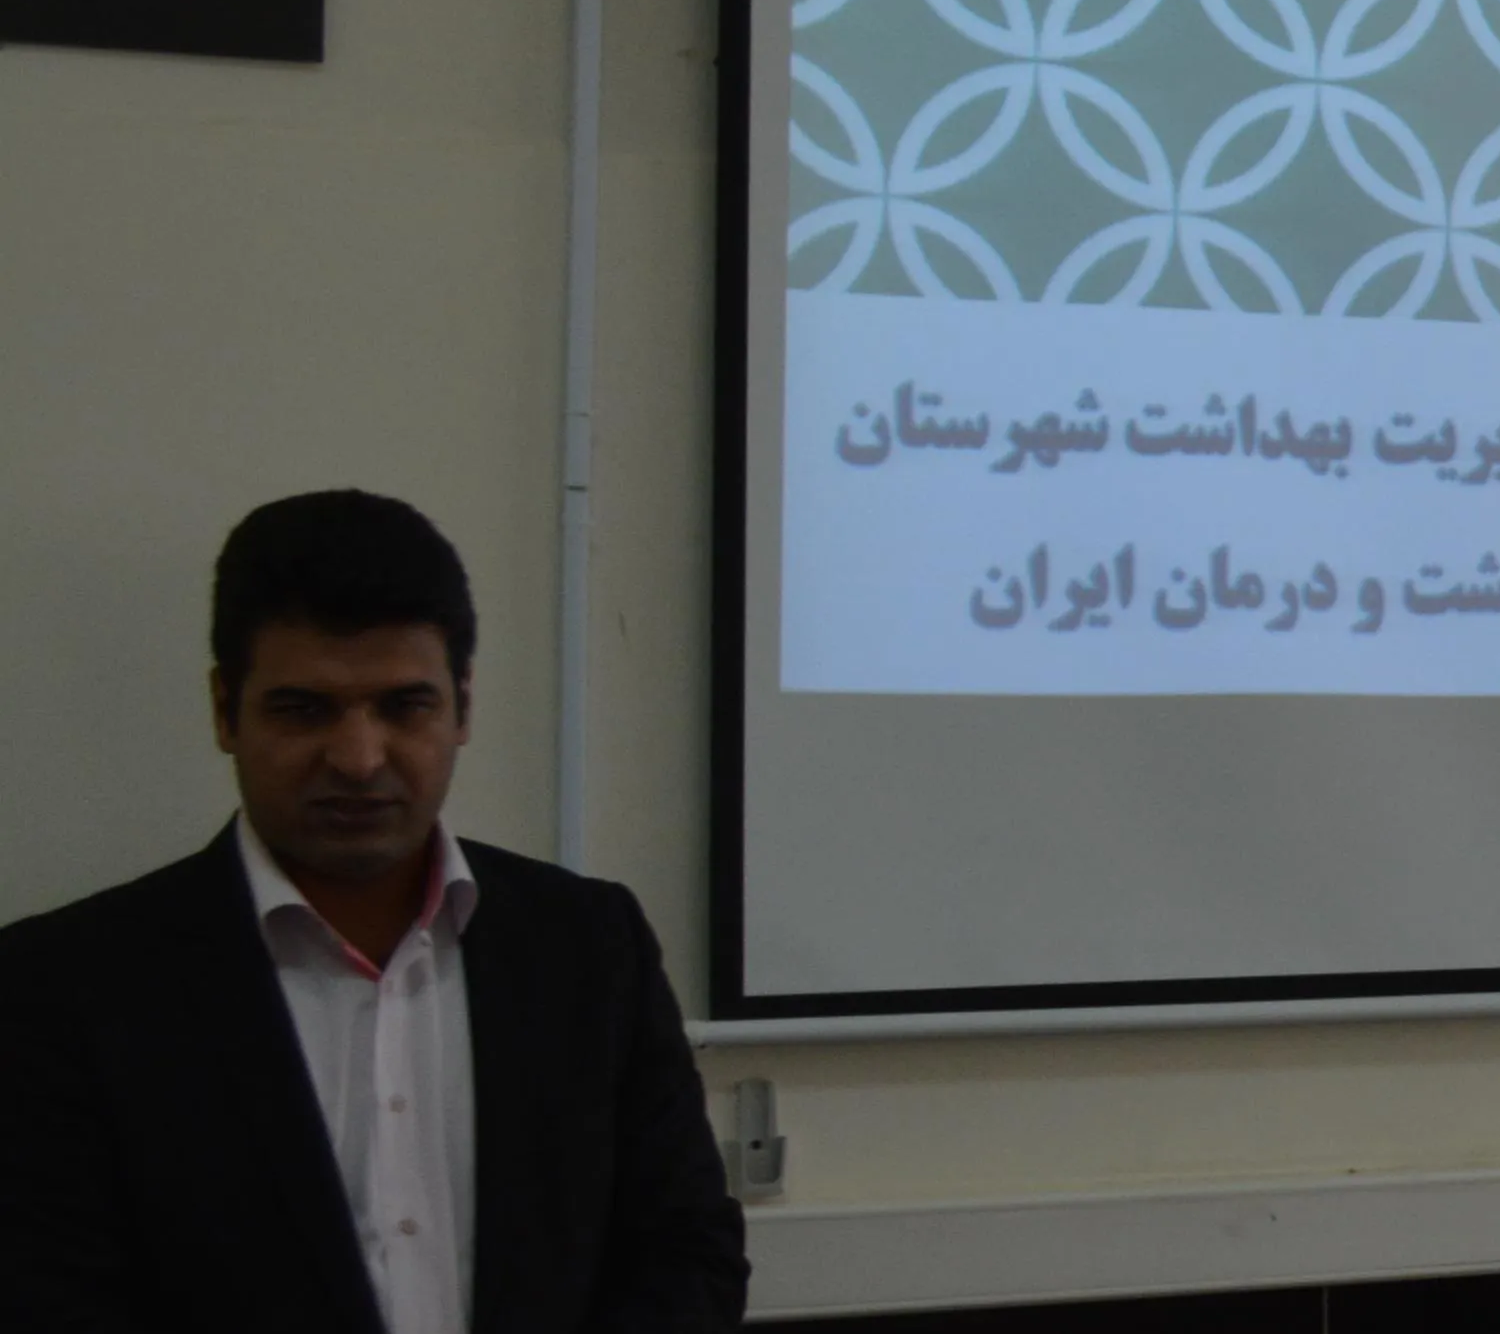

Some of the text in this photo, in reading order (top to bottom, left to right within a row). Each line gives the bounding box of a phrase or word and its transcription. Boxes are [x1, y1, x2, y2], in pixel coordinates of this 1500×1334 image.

[835, 380, 1111, 473] شهرستان
[1124, 394, 1355, 479] بهداشت
[970, 544, 1135, 632] ایران
[1153, 546, 1339, 632] درمان
[1353, 577, 1386, 633] و
